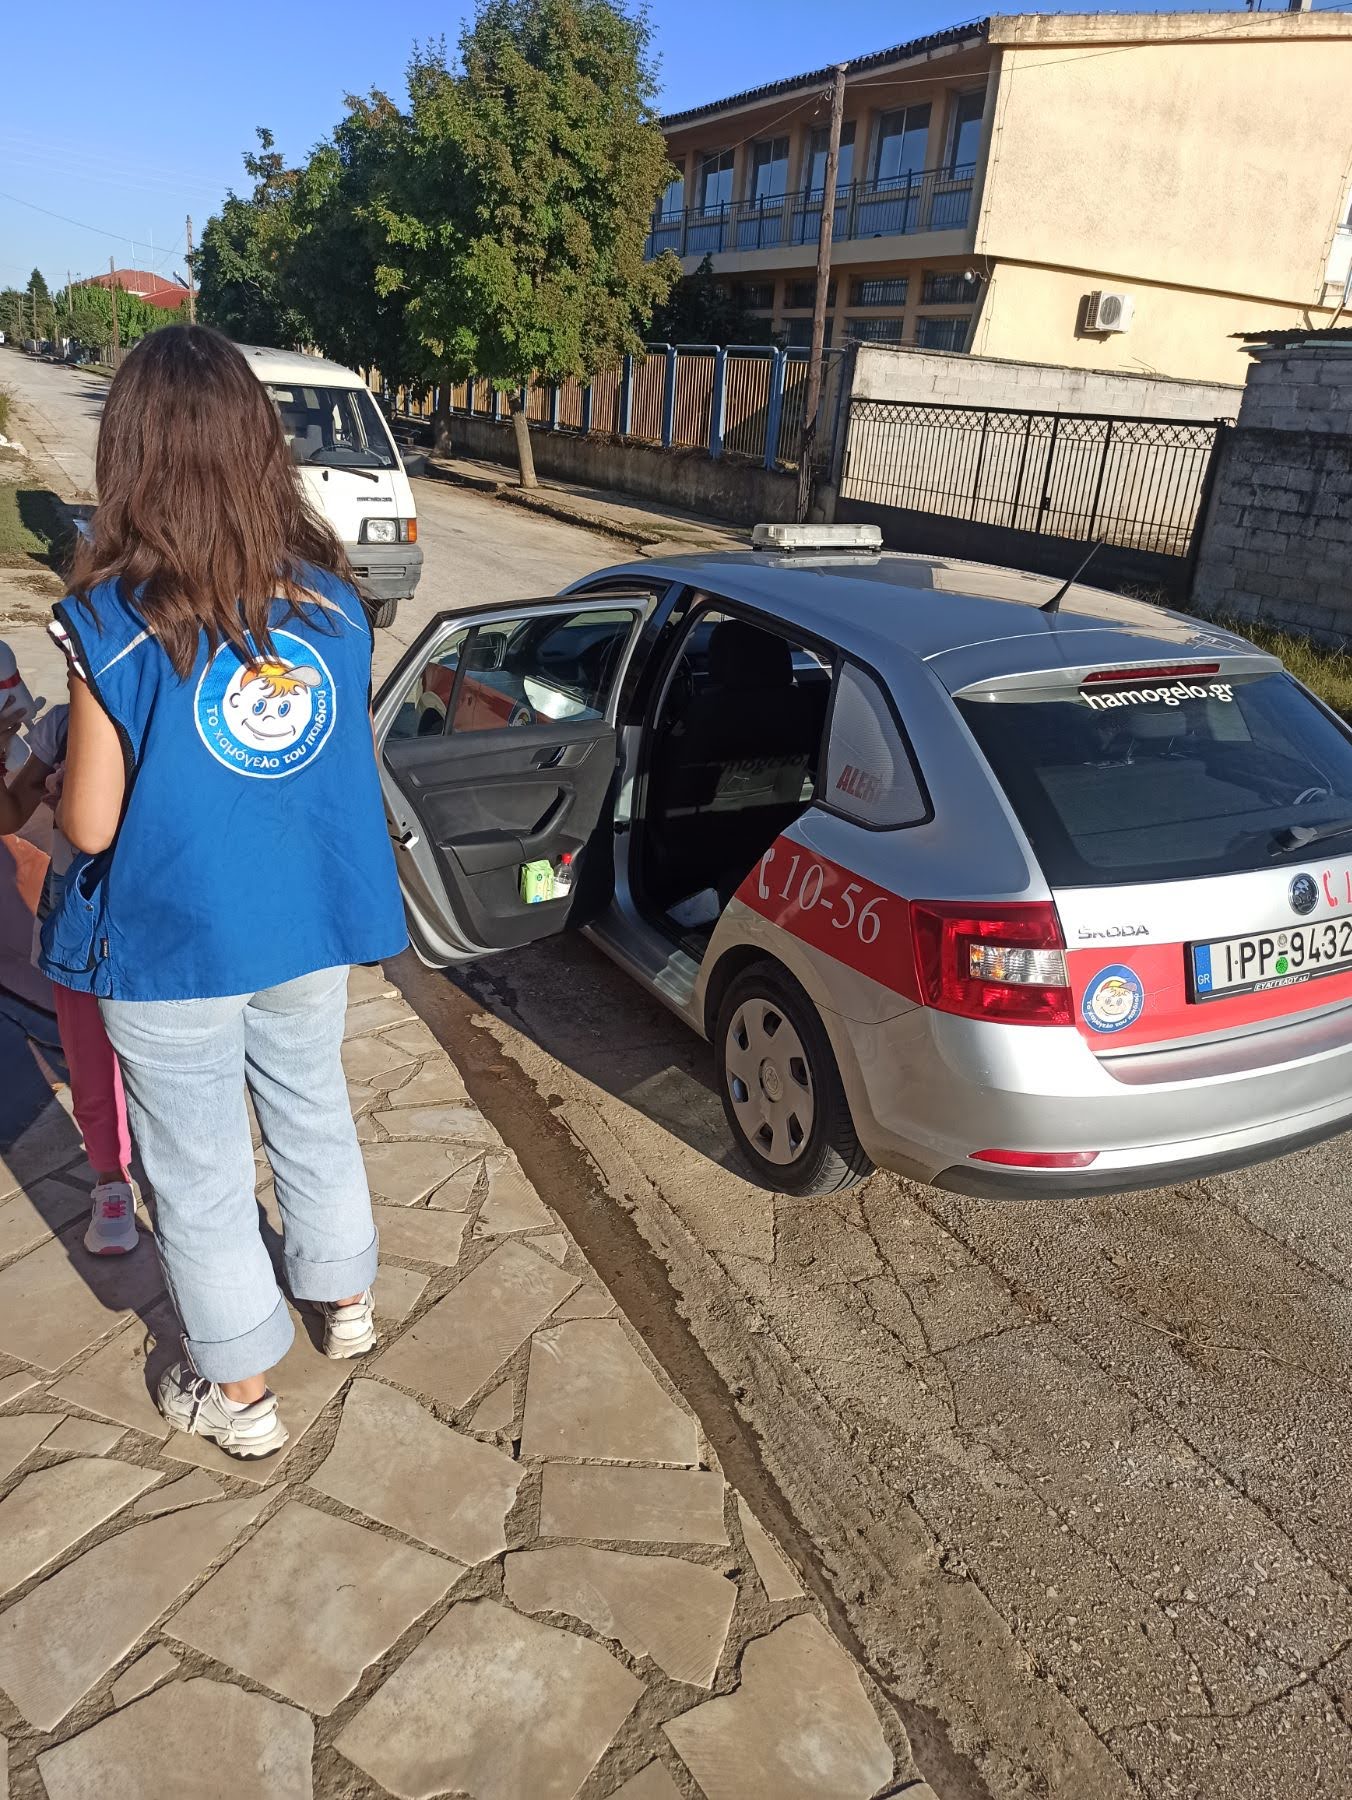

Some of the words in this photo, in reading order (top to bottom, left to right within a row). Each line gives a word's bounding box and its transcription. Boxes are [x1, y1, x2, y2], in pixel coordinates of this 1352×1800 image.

[1080, 681, 1234, 710] hamogelo.gr
[213, 728, 280, 768] χαμόγελο
[283, 745, 307, 764] του
[305, 690, 327, 747] παιδιού
[778, 854, 888, 944] 10-56
[1198, 974, 1211, 985] GR
